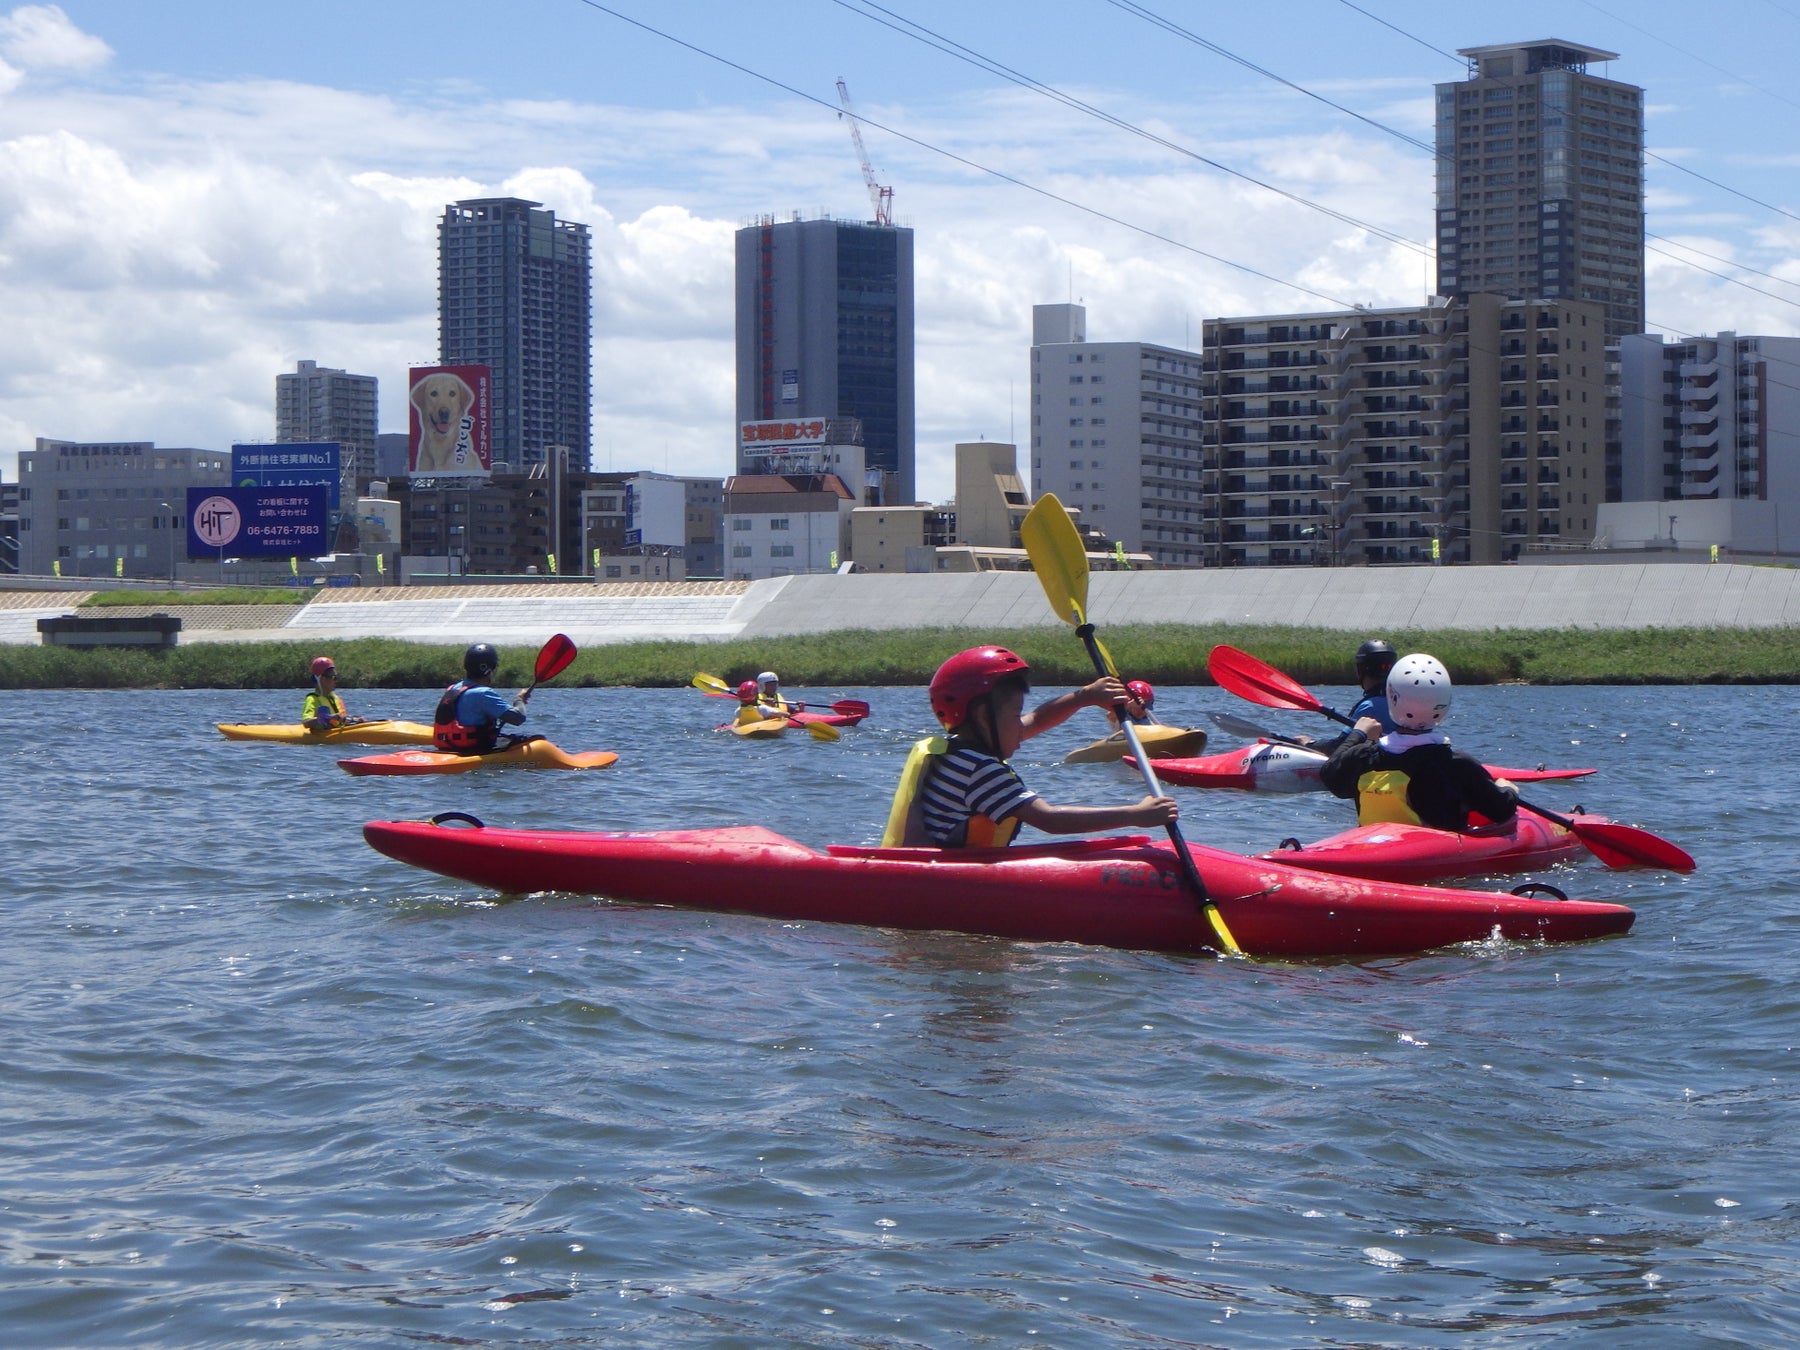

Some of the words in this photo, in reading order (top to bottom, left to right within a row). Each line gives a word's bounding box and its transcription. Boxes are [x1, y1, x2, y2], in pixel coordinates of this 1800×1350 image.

[742, 421, 824, 442] 宝塚医療大学
[257, 498, 309, 506] この看板に関する
[259, 509, 308, 517] お問い合わせは
[247, 526, 319, 535] 06-6476-7883
